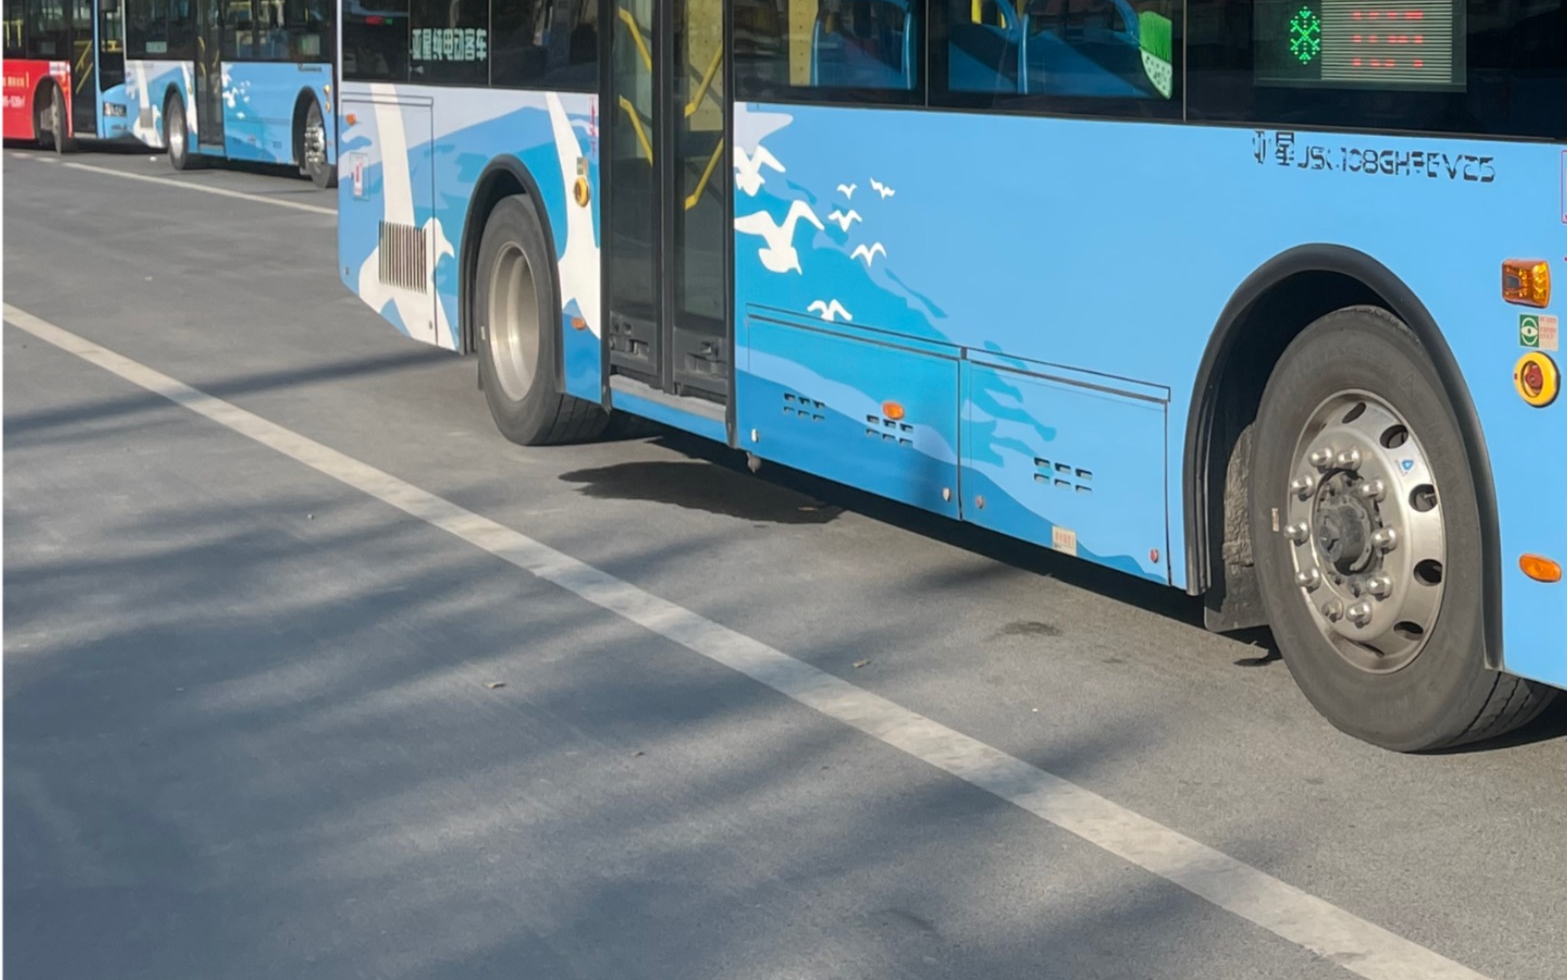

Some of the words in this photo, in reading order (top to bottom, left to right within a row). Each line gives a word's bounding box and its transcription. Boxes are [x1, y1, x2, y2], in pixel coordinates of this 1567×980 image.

[412, 27, 487, 62] 亚星纯电动客车
